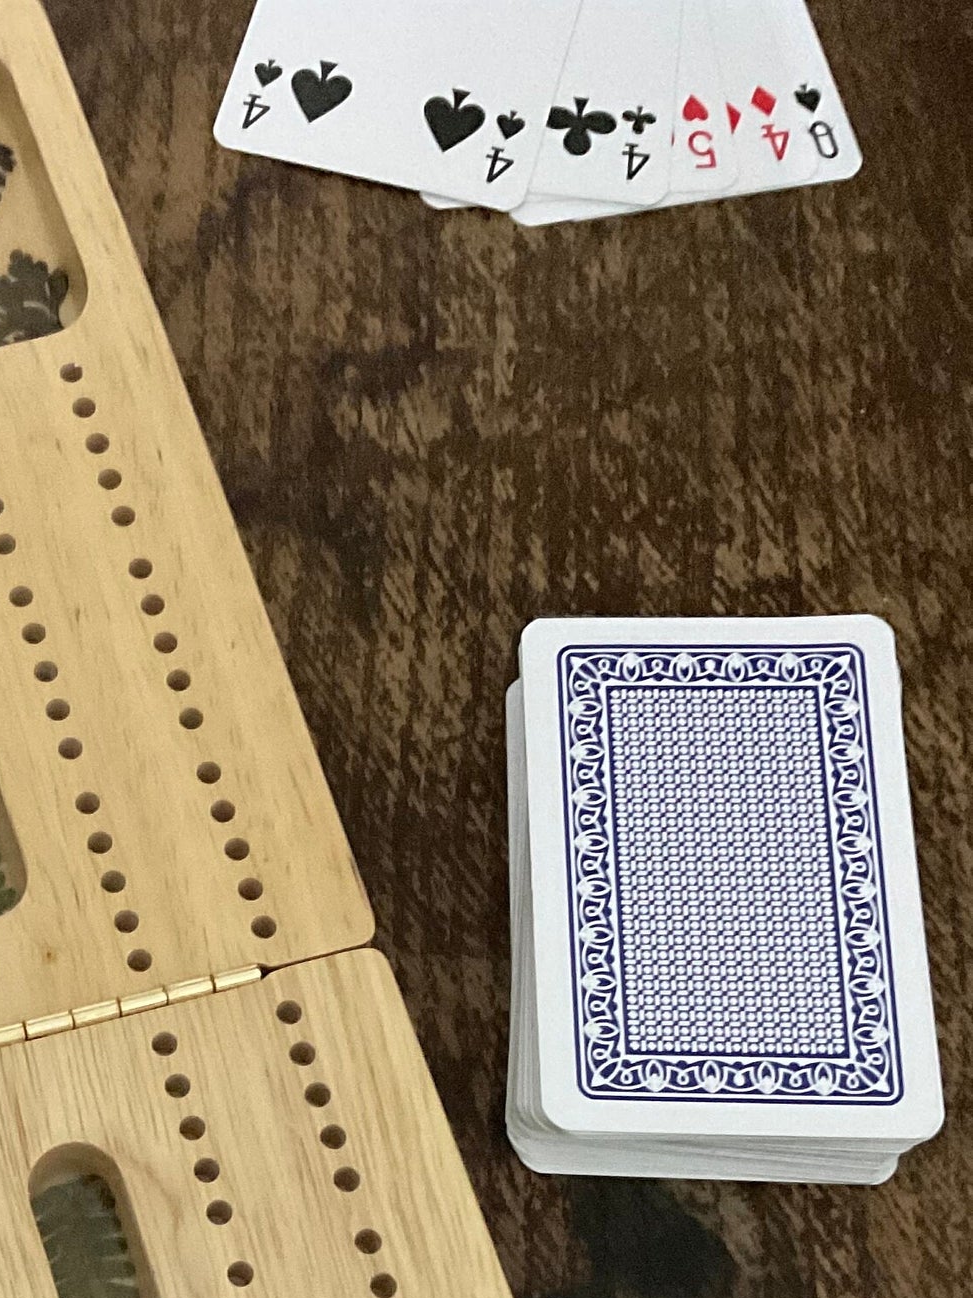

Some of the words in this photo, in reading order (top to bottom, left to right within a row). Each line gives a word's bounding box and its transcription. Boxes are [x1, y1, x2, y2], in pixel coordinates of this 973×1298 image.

[241, 93, 270, 130] 4
[687, 130, 717, 169] 5
[761, 124, 790, 161] 4
[485, 146, 515, 184] 4
[621, 143, 650, 181] 4
